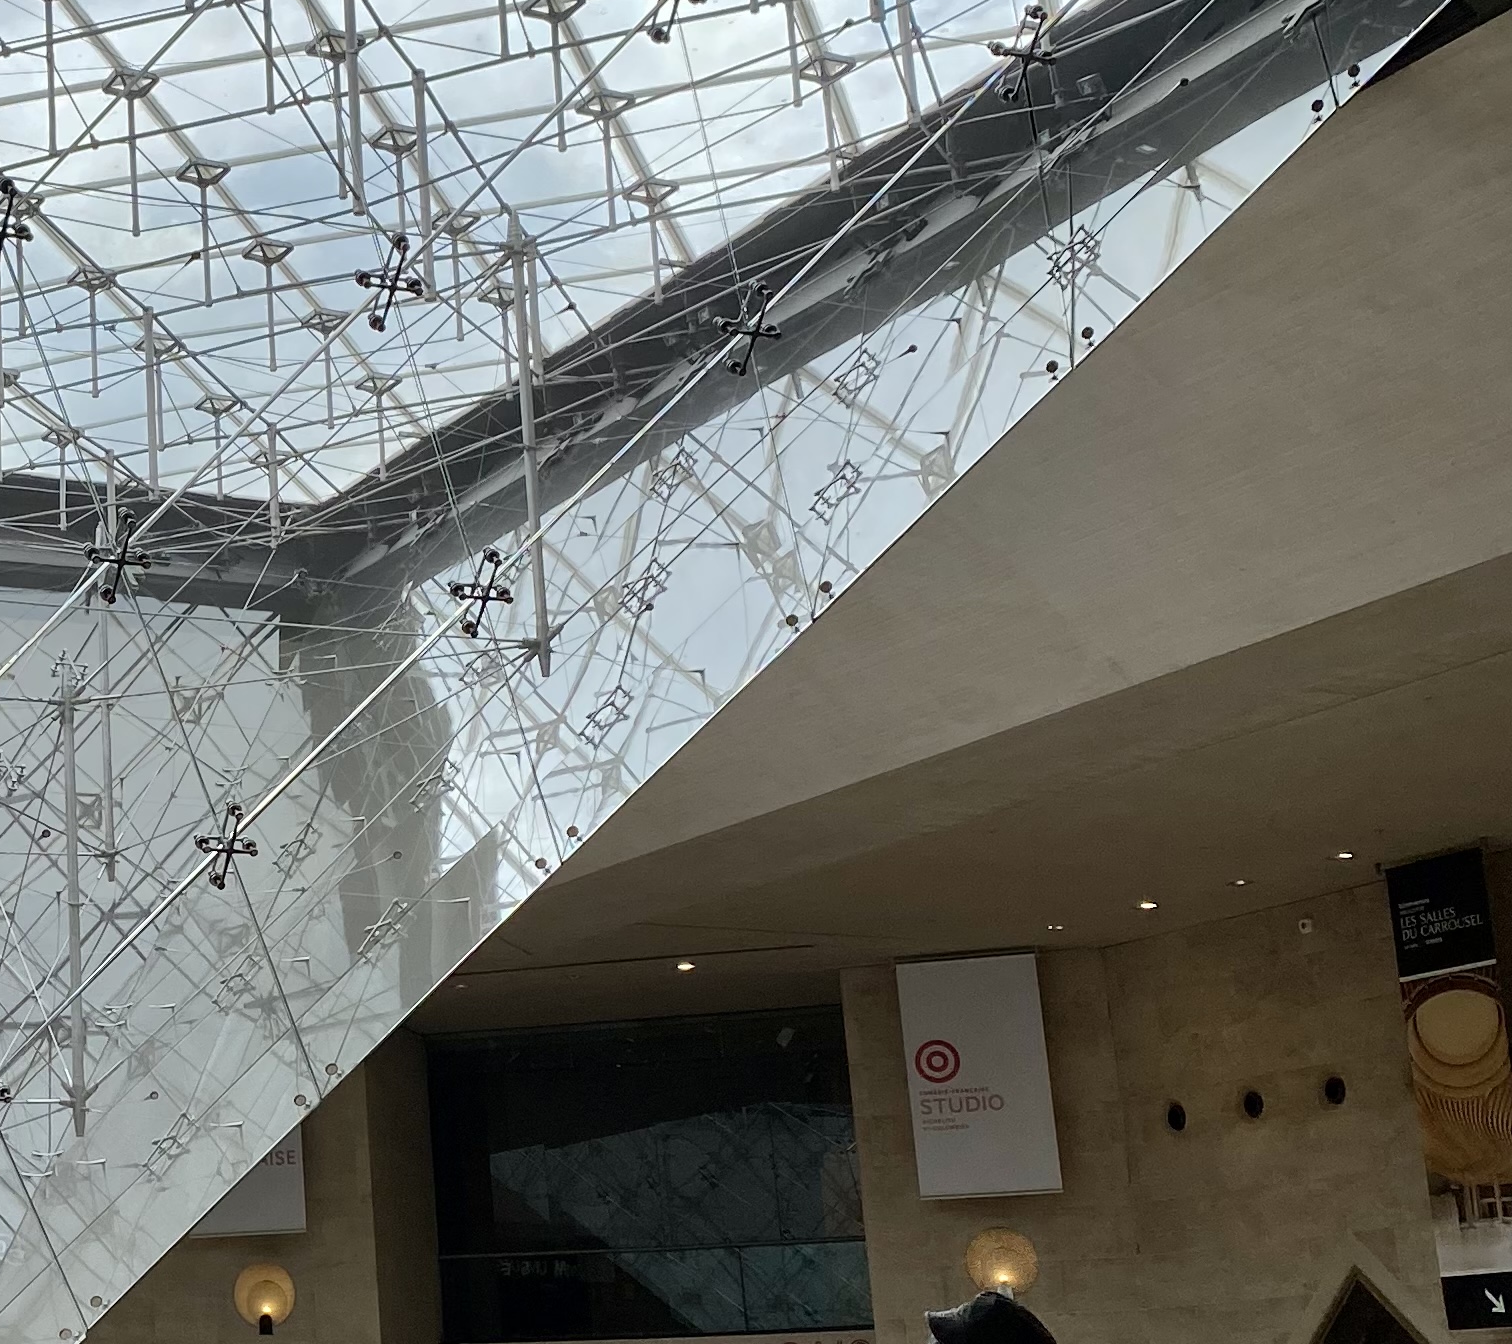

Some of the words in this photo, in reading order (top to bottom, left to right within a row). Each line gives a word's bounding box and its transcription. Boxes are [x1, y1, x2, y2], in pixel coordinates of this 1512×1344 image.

[1400, 916, 1416, 929] LES
[1419, 907, 1456, 925] SALLES
[1402, 928, 1418, 941] DU
[1420, 914, 1484, 937] CARROUSEL
[920, 1094, 1005, 1115] STUDIO
